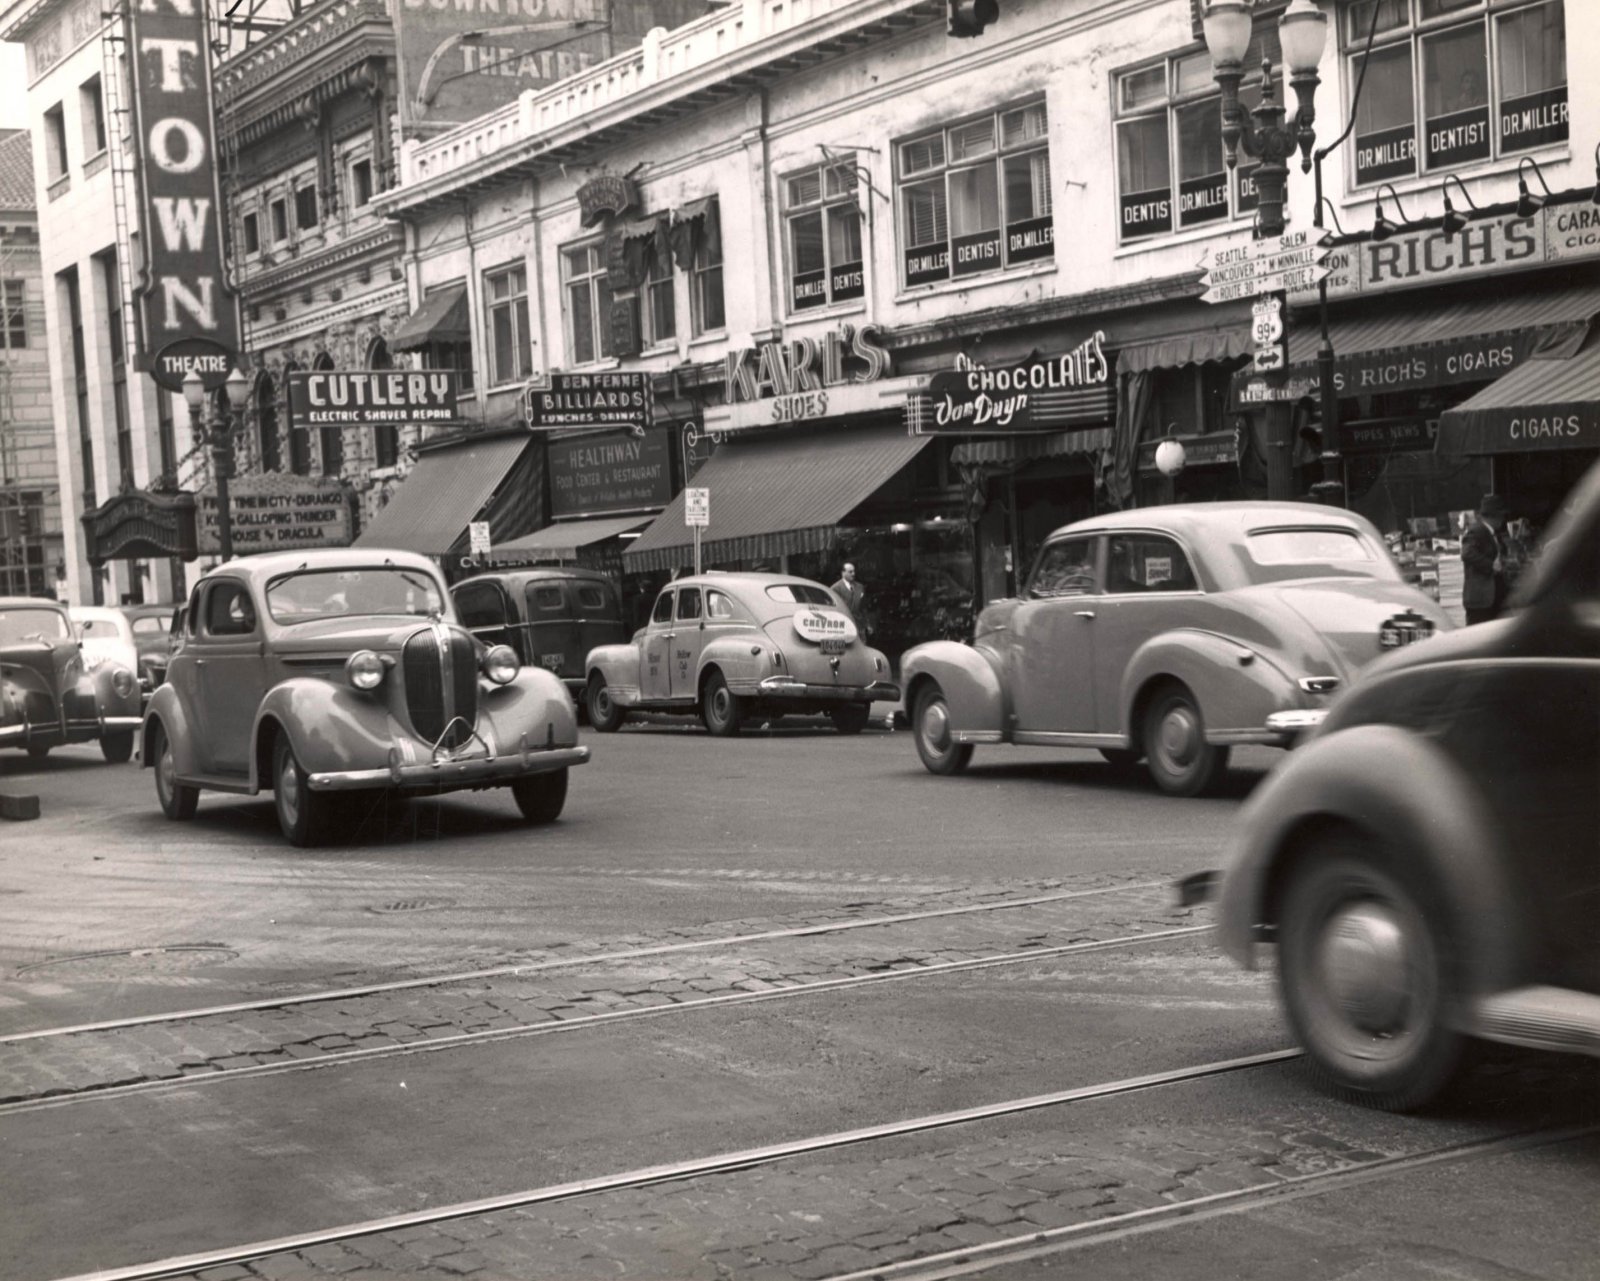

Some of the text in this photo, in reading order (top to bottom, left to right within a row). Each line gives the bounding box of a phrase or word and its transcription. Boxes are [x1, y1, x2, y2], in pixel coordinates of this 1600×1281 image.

[459, 44, 595, 80] THEATRE
[1431, 121, 1486, 153] DENTIST
[140, 0, 217, 330] TOWN
[1124, 200, 1172, 224] DENTIS
[958, 240, 1001, 262] DENTIST
[1280, 231, 1307, 251] SALEM
[1368, 218, 1535, 283] RICH'S
[1566, 233, 1600, 248] CIG
[1215, 246, 1248, 266] SEATTLE
[834, 271, 864, 290] DENTIS
[1210, 262, 1254, 284] VANCOUVER
[1283, 270, 1306, 287] ROUTE
[1310, 268, 1314, 282] 2
[1220, 283, 1242, 300] ROUTE
[1244, 281, 1254, 295] 30
[163, 355, 227, 373] THEATRE
[725, 323, 891, 403] KARL'S
[967, 330, 1108, 390] CHOCOLATES
[1361, 359, 1426, 387] RICH'S
[1447, 347, 1513, 374] CIGARS
[308, 374, 449, 406] CUTLERY
[542, 391, 644, 409] BILLIARDS
[310, 409, 452, 422] ELECTRIC SHAVER REPAIR
[771, 391, 829, 421] SHOES
[1353, 427, 1383, 441] PIPES
[1390, 424, 1419, 438] NEWS
[1510, 416, 1580, 440] CIGARS
[569, 441, 641, 469] HEALTHWAY
[556, 475, 573, 490] FOOD
[576, 472, 600, 488] CENTER
[613, 464, 661, 483] RESTAURANT
[234, 496, 257, 508] TIME
[237, 512, 291, 525] GALLOPING
[294, 510, 337, 523] THUNDER
[278, 527, 324, 540] DRACULA
[803, 616, 845, 629] CHEVRON
